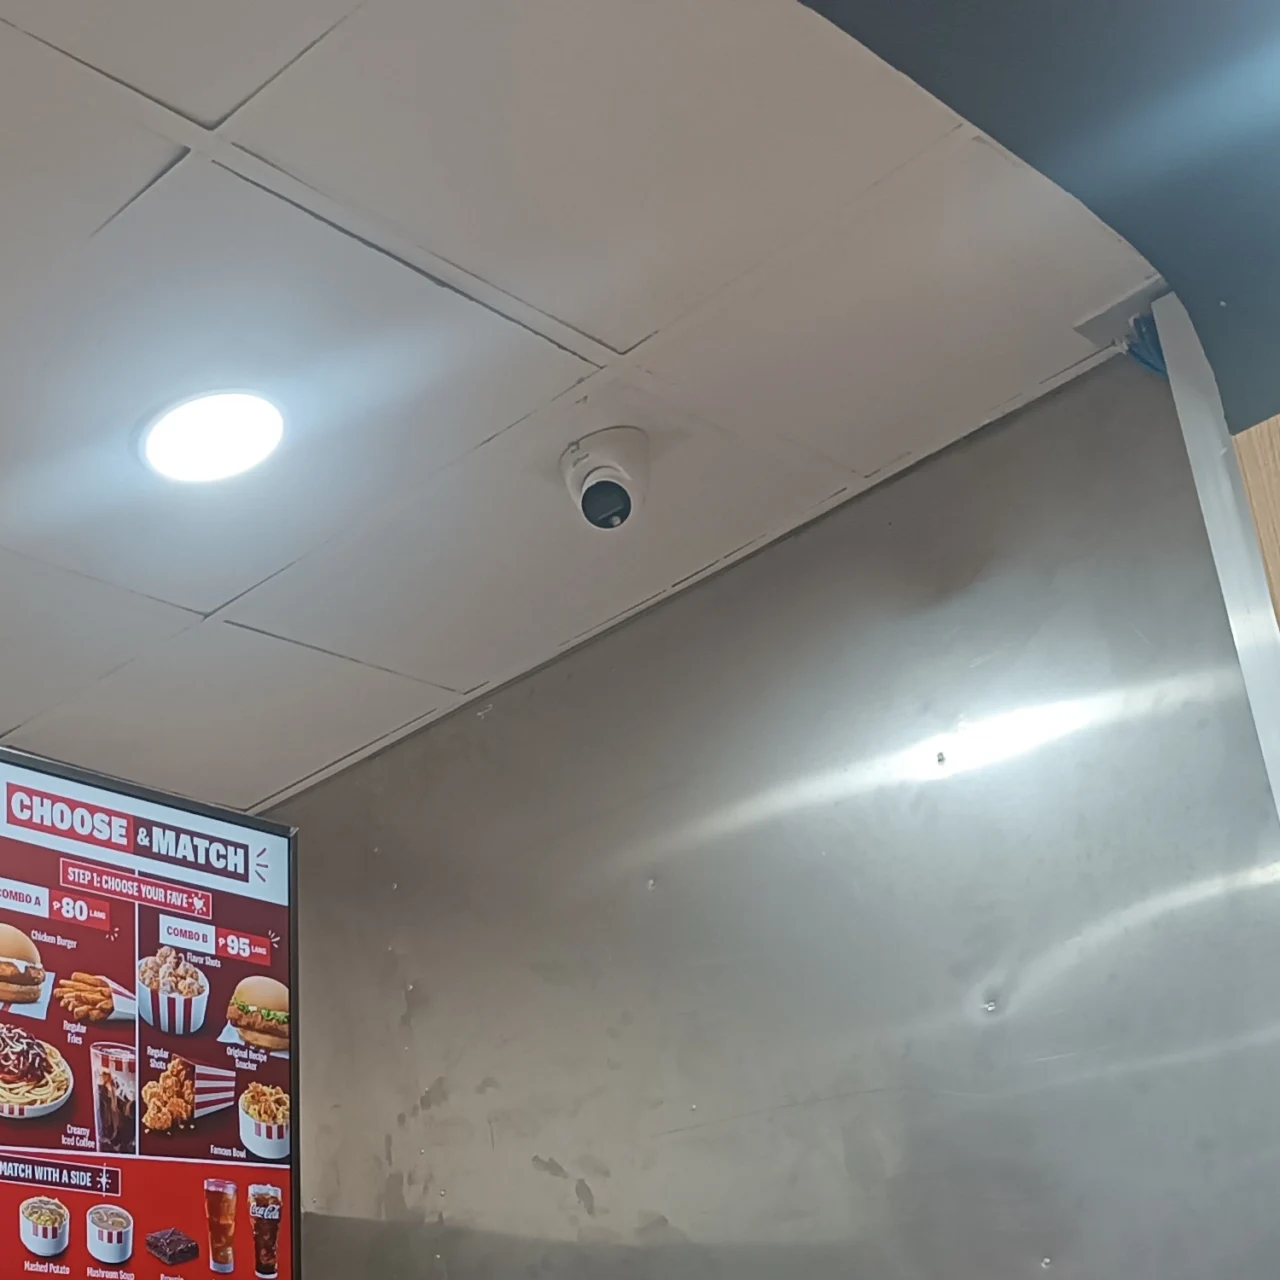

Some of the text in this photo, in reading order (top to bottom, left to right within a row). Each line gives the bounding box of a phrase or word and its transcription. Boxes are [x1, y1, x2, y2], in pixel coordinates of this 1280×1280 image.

[11, 791, 245, 874] CHOOSE & MATCH
[67, 867, 188, 907] STEP CHOOSE YOUR FAVE
[34, 896, 41, 907] A
[31, 929, 77, 949] Chicken Burger
[167, 926, 208, 943] COMBO B
[186, 952, 204, 966] Flavor
[63, 1020, 87, 1034] Regular
[67, 1033, 83, 1045] Fries
[147, 1046, 169, 1060] Regular
[150, 1058, 166, 1070] Shots
[67, 1124, 90, 1138] Creamy
[61, 1134, 96, 1149] Iced Coffee
[210, 1145, 246, 1159] Famous Bowl
[0, 1161, 32, 1179] MATCH
[34, 1165, 60, 1183] WITH
[61, 1170, 69, 1184] A
[70, 1171, 92, 1187] SIDE
[24, 1260, 70, 1275] Mashed Potato
[86, 1267, 118, 1279] Mushroom
